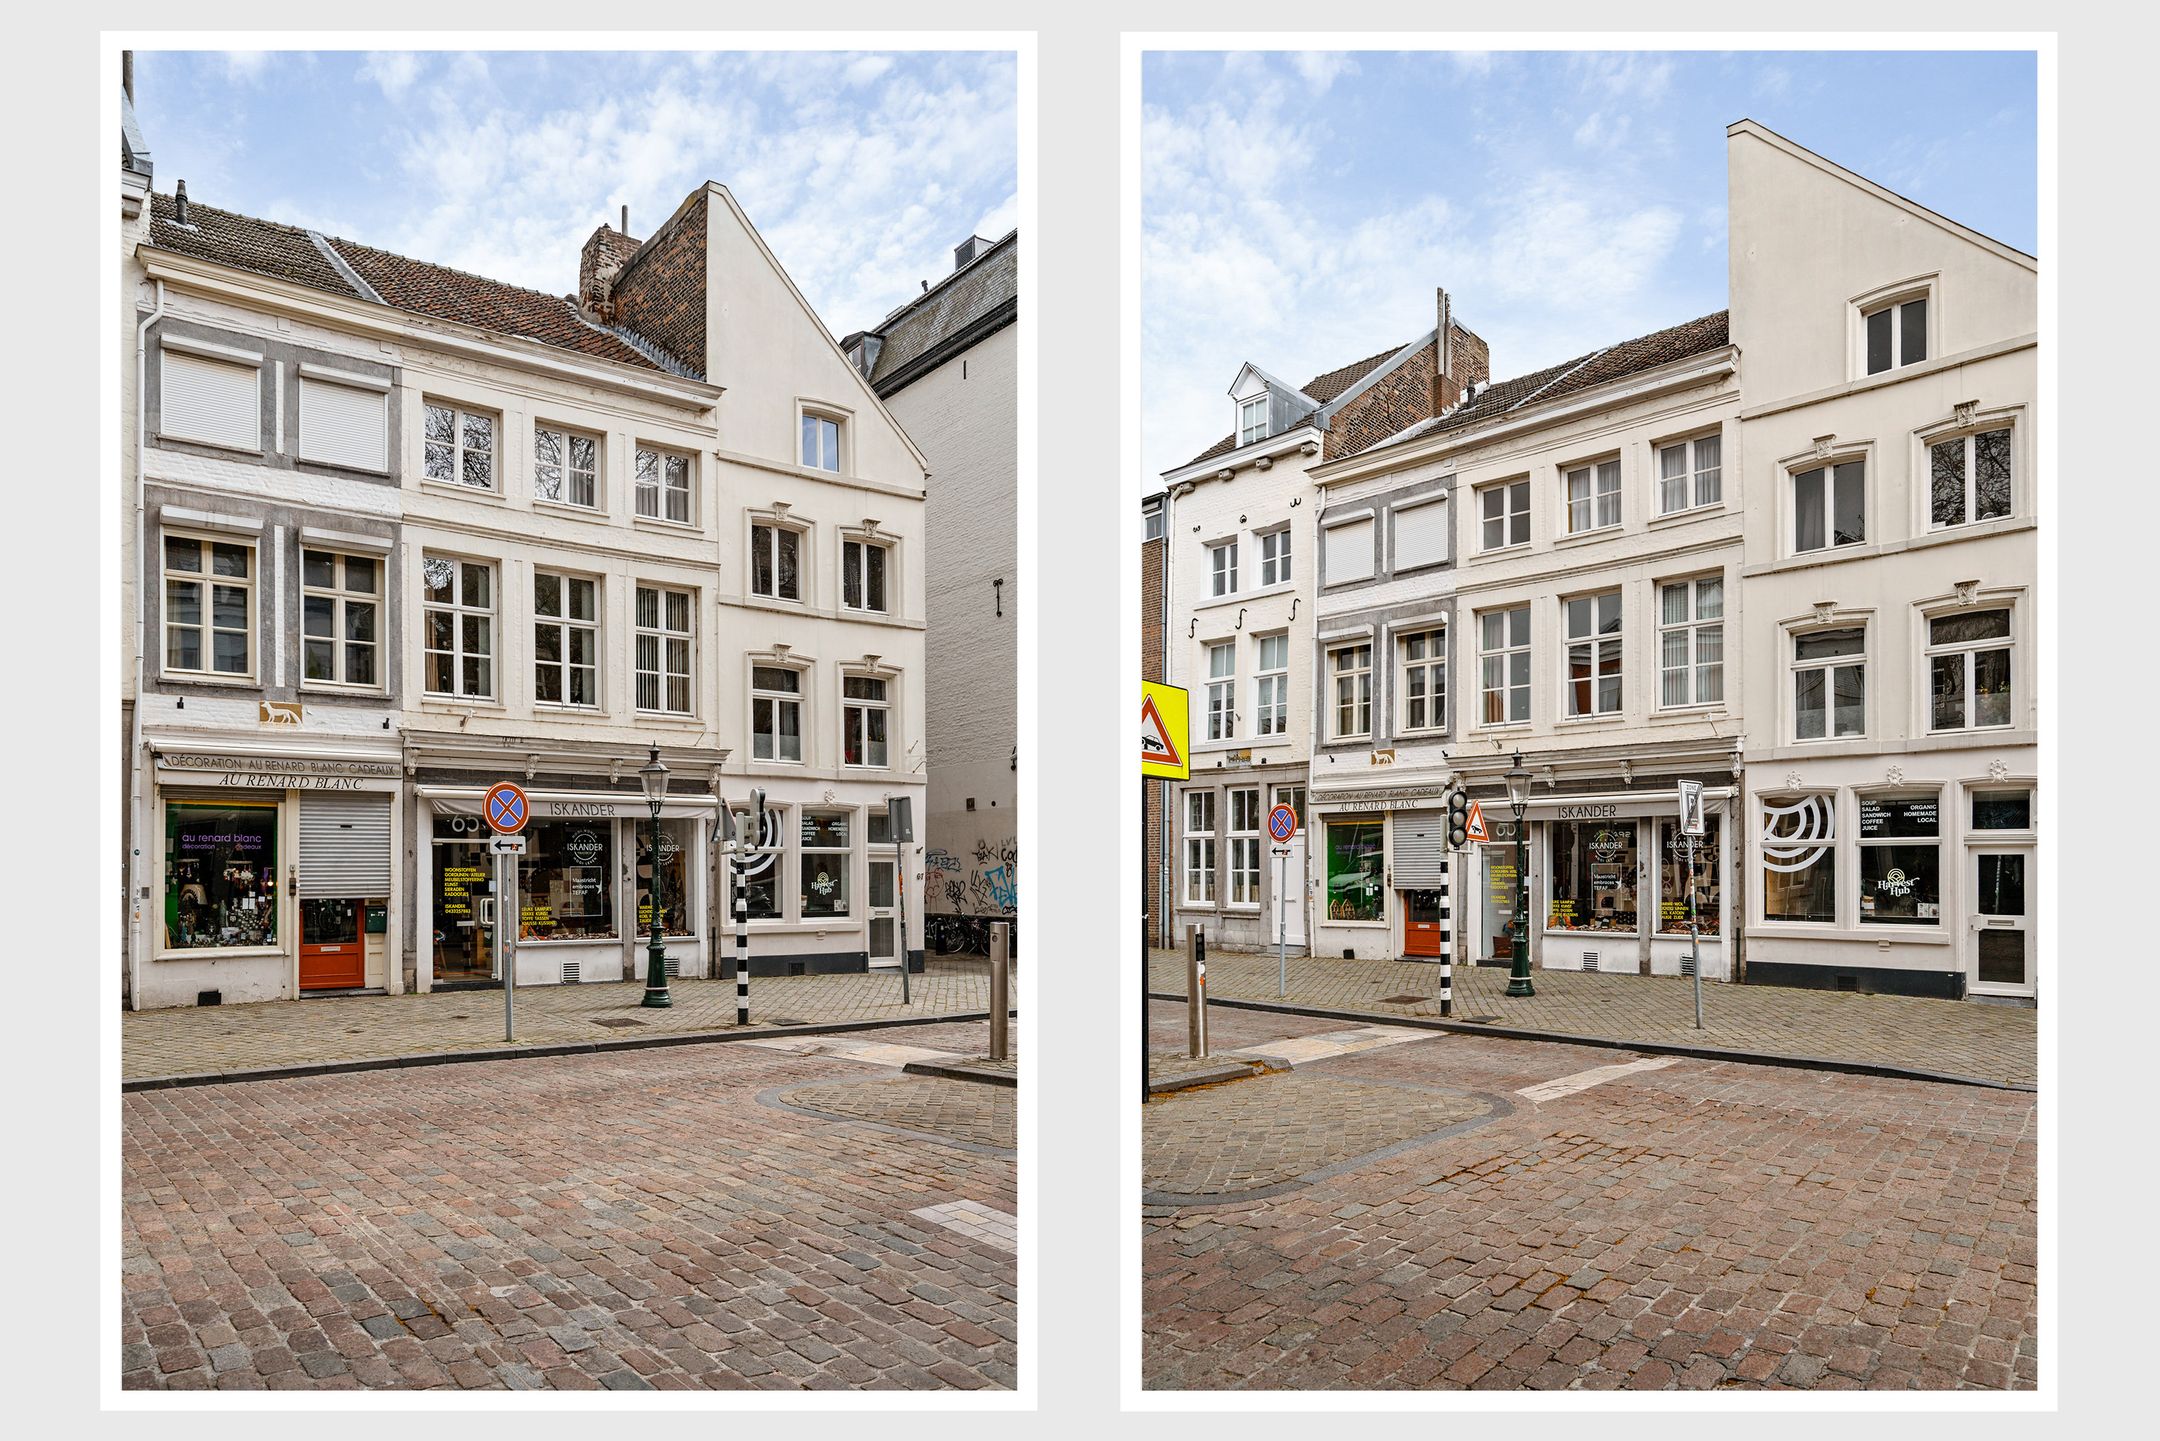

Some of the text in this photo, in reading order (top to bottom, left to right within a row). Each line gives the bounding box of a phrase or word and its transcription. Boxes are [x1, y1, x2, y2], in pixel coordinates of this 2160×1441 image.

[171, 754, 395, 776] DÉCORATION AU RENARD BLANC CADEAUX
[219, 774, 364, 790] AU RENARD BLANC
[550, 803, 615, 816] ISKANDER
[1339, 800, 1418, 812] AU RENARD BLANC
[1558, 804, 1616, 819] ISKANDER
[198, 833, 231, 842] renard
[233, 833, 262, 843] blanc
[566, 842, 604, 851] ISKANDER
[646, 844, 680, 852] ISANDER
[1588, 841, 1623, 850] ISKANDER
[1666, 840, 1704, 849] ISKANDER
[1878, 876, 1920, 890] Harvest
[1890, 886, 1910, 896] Hub
